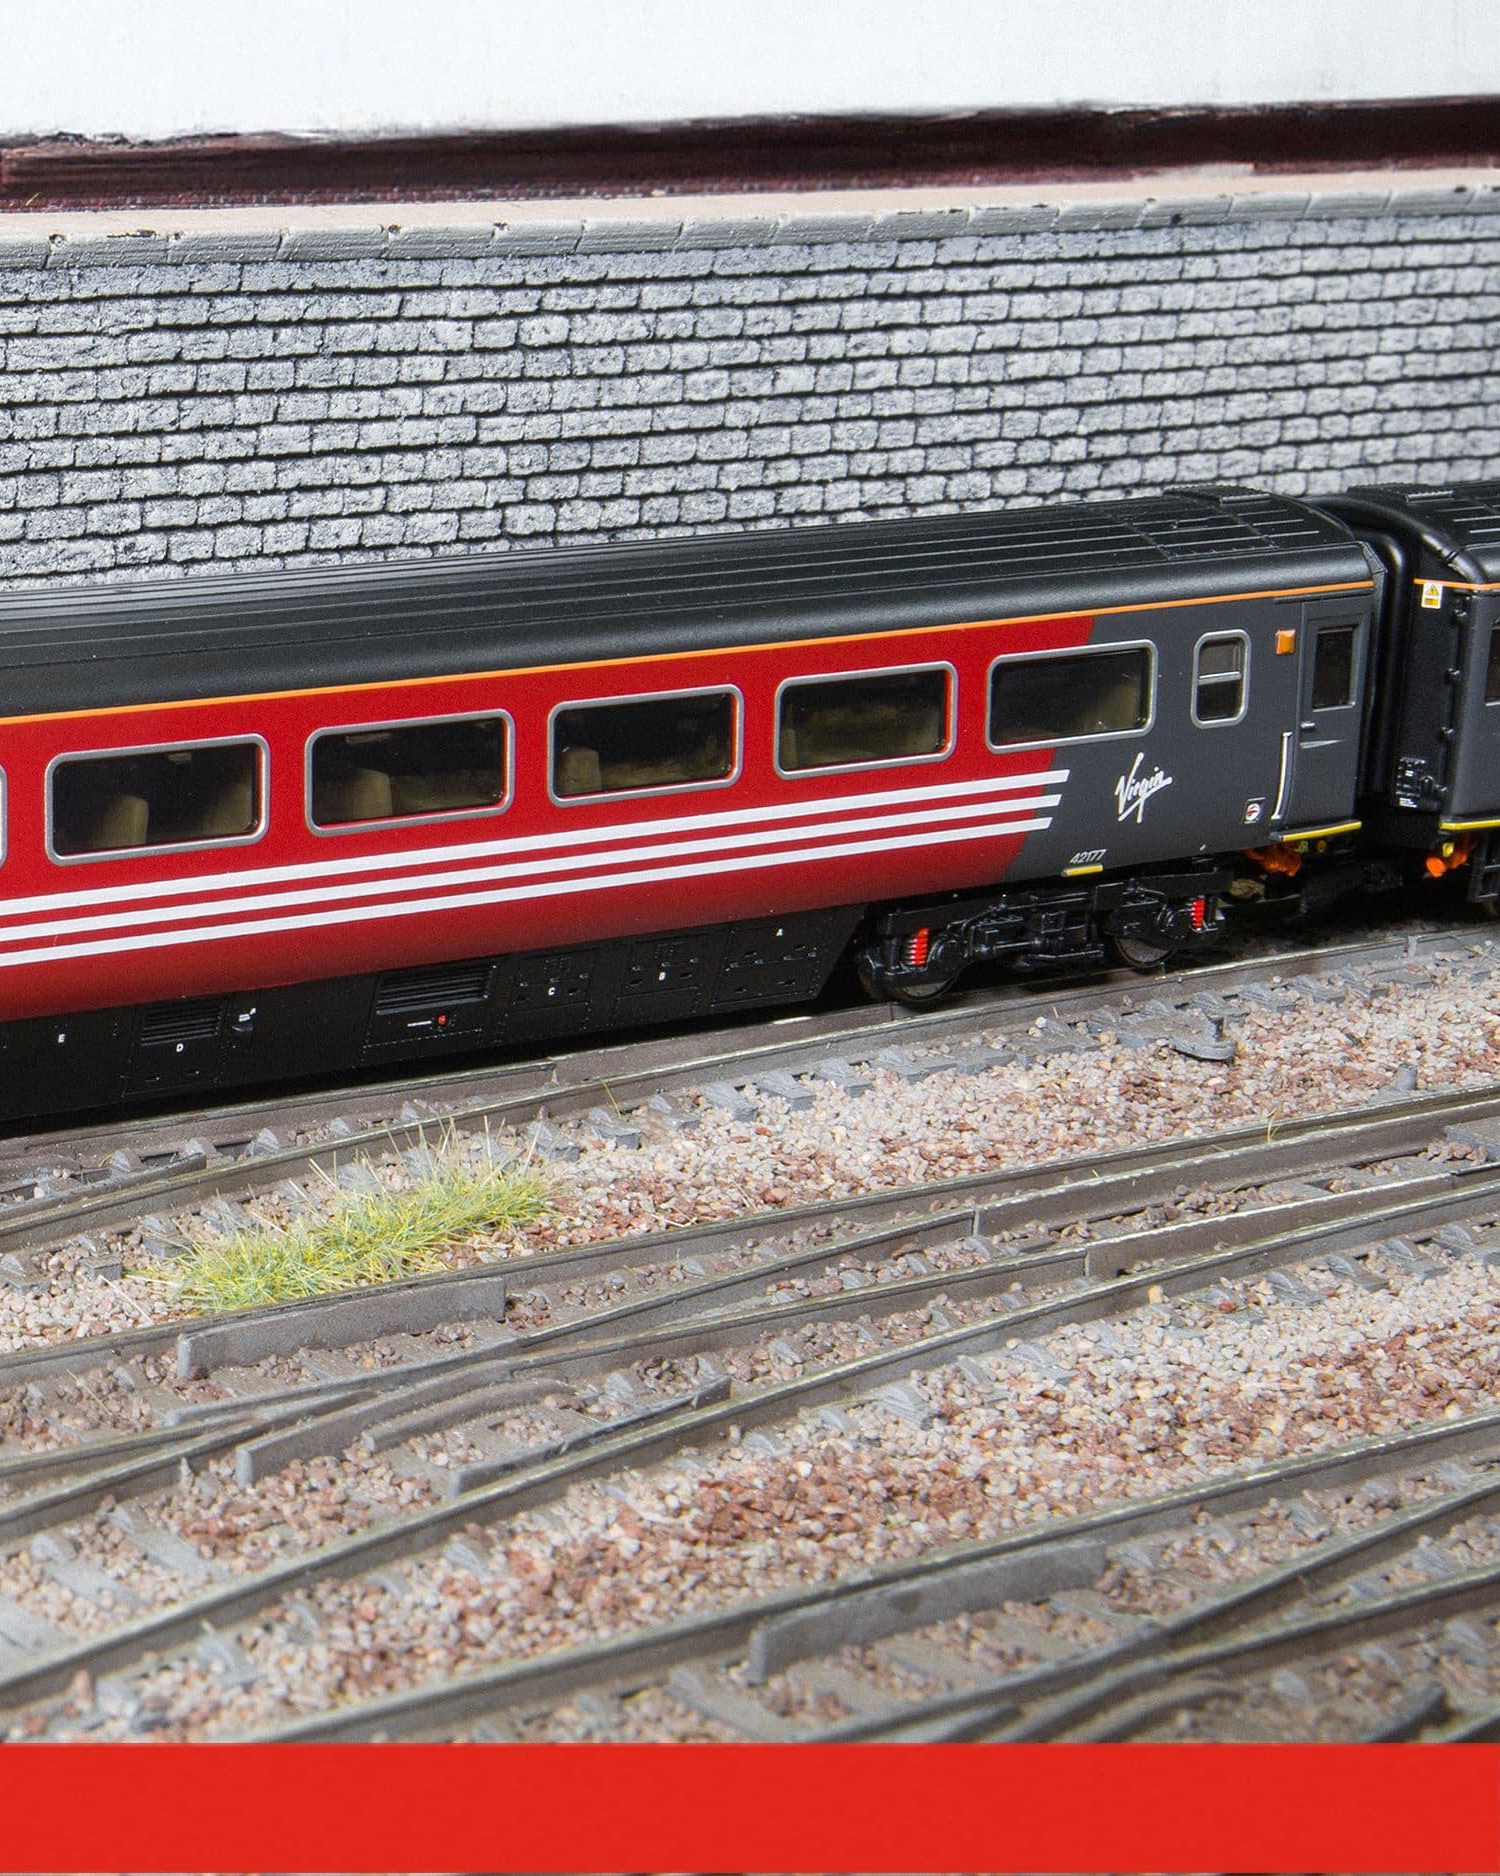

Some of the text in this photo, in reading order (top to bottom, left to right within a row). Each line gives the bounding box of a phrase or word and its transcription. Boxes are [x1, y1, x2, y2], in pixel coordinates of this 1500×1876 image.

[1114, 752, 1173, 823] Virgin
[1069, 848, 1108, 864] 42177
[57, 1033, 66, 1043] E
[175, 1043, 184, 1053] D
